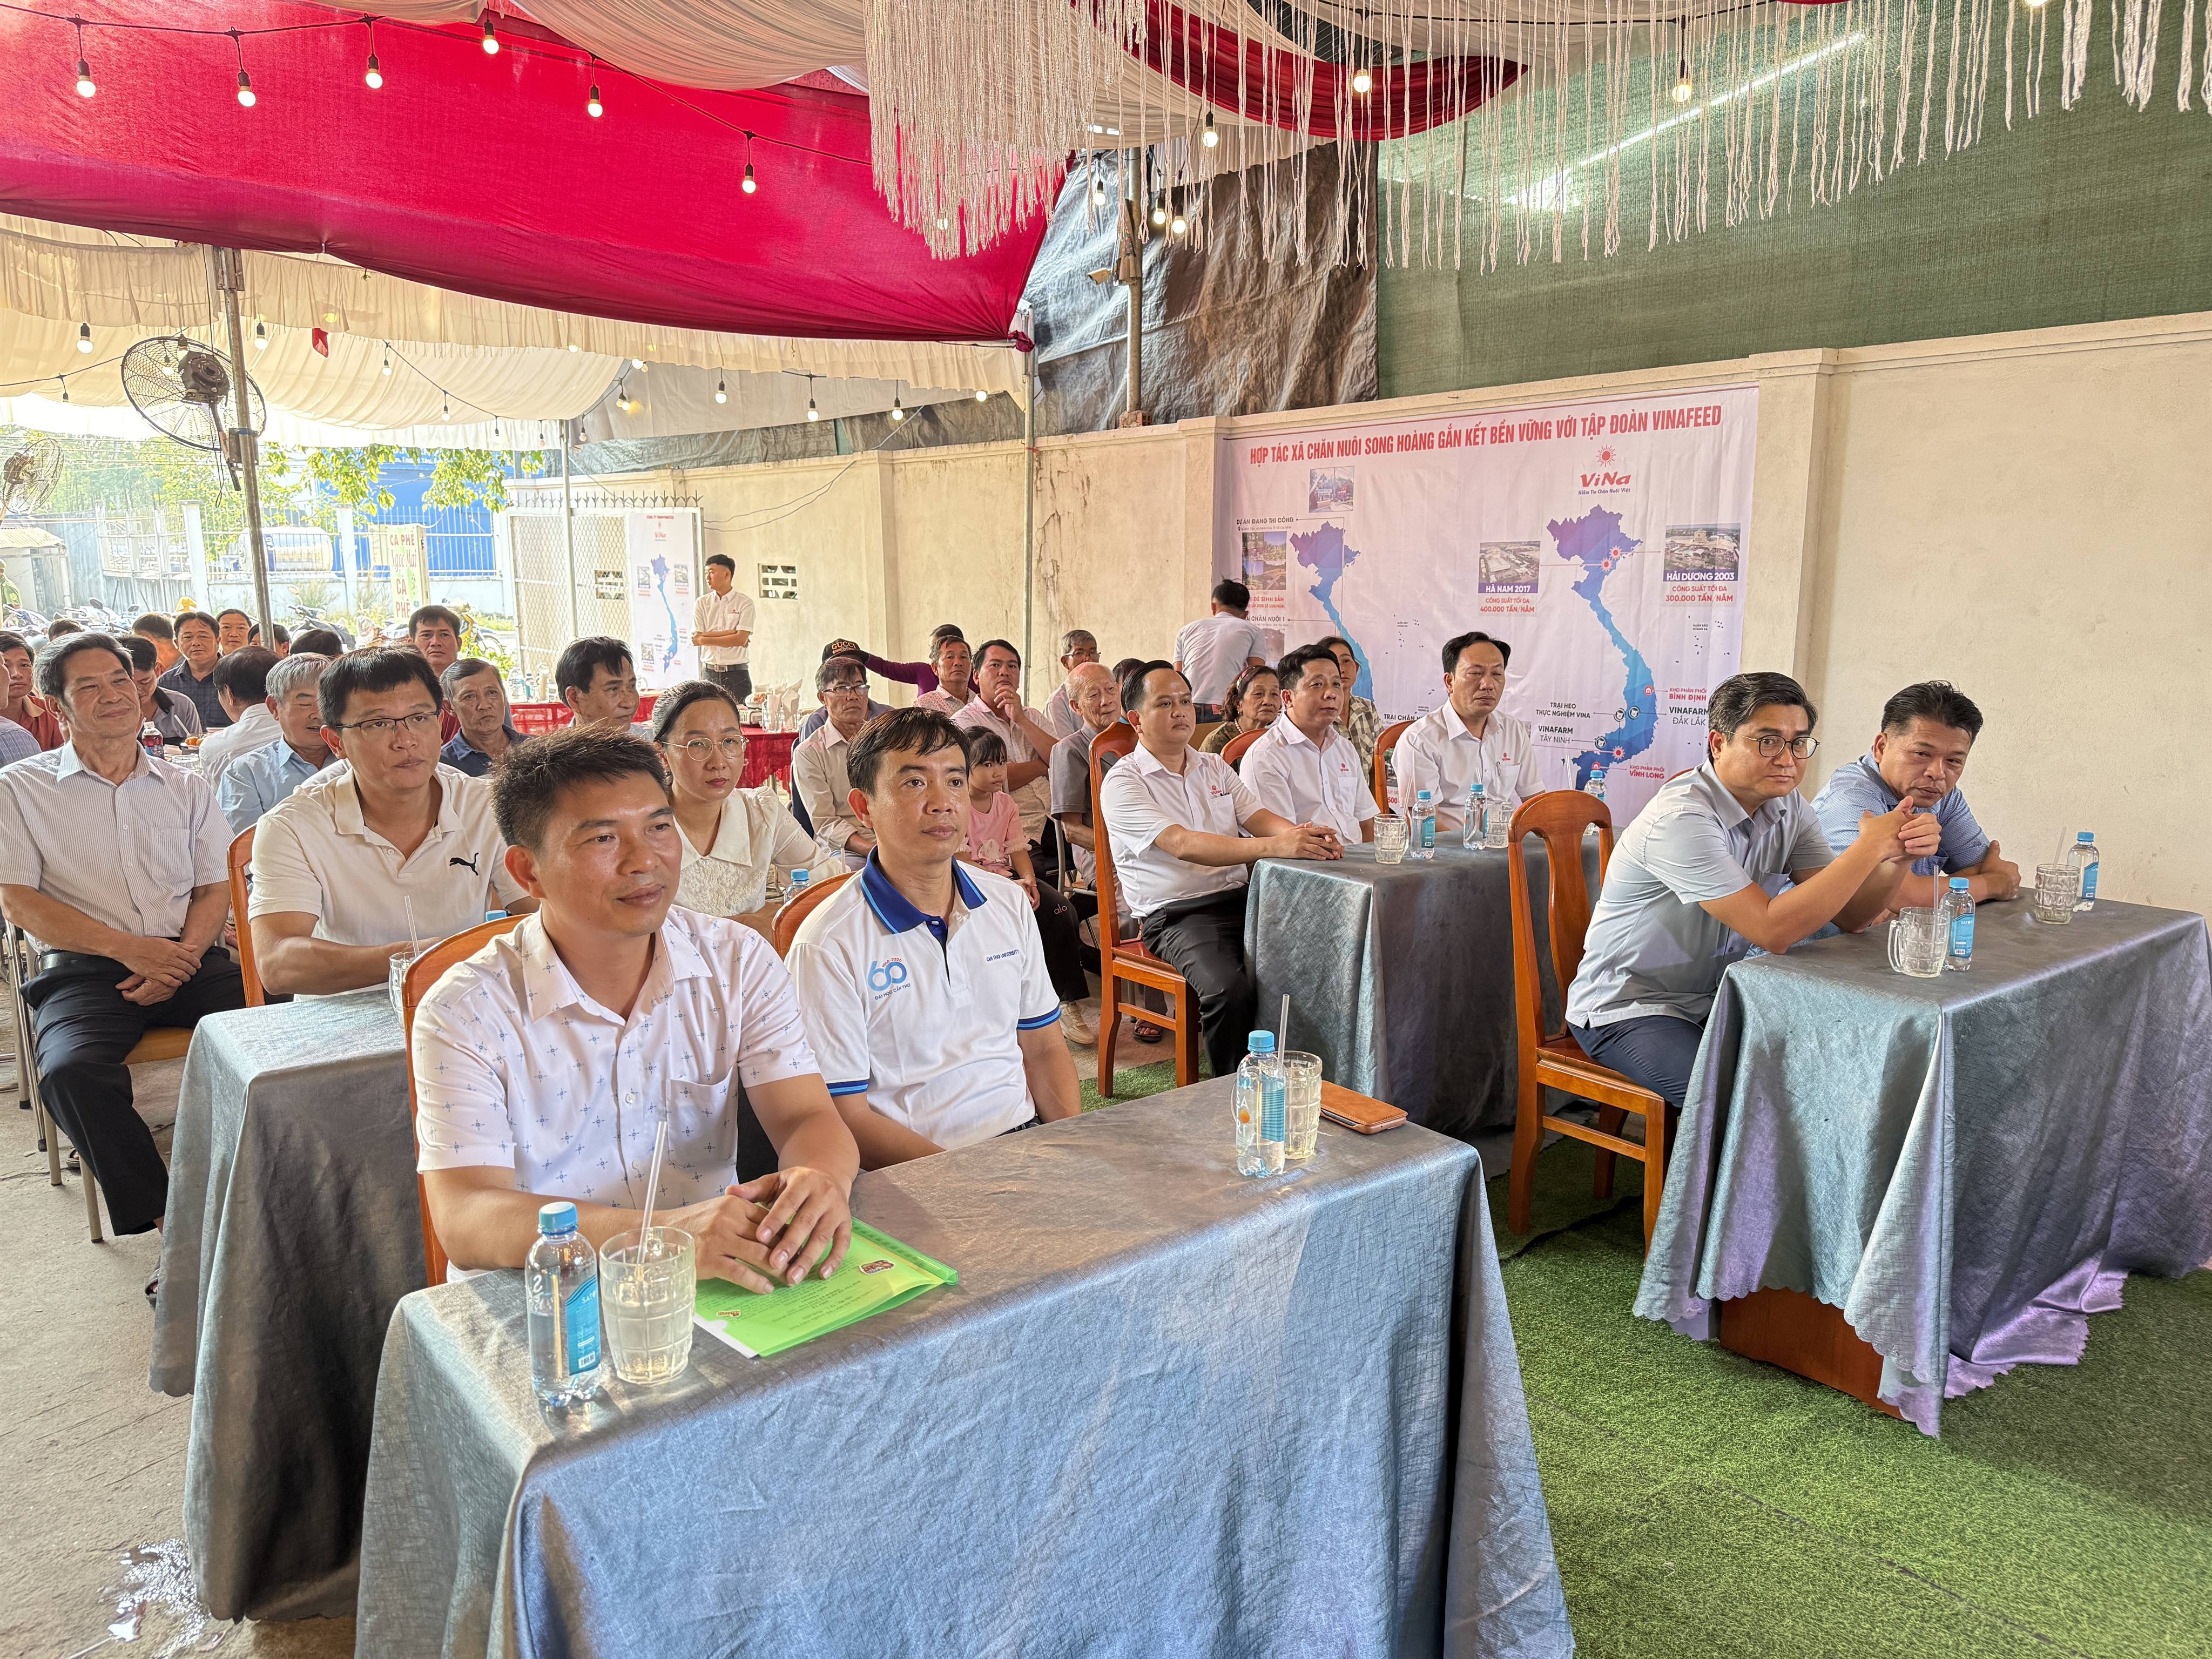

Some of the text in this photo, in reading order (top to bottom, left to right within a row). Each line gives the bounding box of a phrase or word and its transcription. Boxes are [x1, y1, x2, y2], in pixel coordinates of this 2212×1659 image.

[1250, 405, 1722, 467] HỢP TÁC XÃ CHĂN NUÔI SONG HOÀNG GẮN KẾT BỀN VỮNG VỚI TẬP ĐOÀN VINAFEED
[1667, 570, 1735, 581] HẢI DƯƠNG 2003
[1486, 584, 1496, 593] HÀ
[1691, 584, 1706, 592] SUẤT
[1708, 584, 1717, 592] TỐI
[832, 641, 857, 650] GUCCI
[1384, 713, 1396, 721] TRẠI
[1536, 709, 1551, 717] THỰC
[1552, 710, 1575, 719] NGHIỆM
[1673, 715, 1706, 725] ĐẮK LẮK
[1538, 725, 1573, 734] VINAFARM
[1540, 734, 1552, 742] TÂY
[1629, 770, 1645, 778] VĨNH
[1054, 903, 1068, 915] alo
